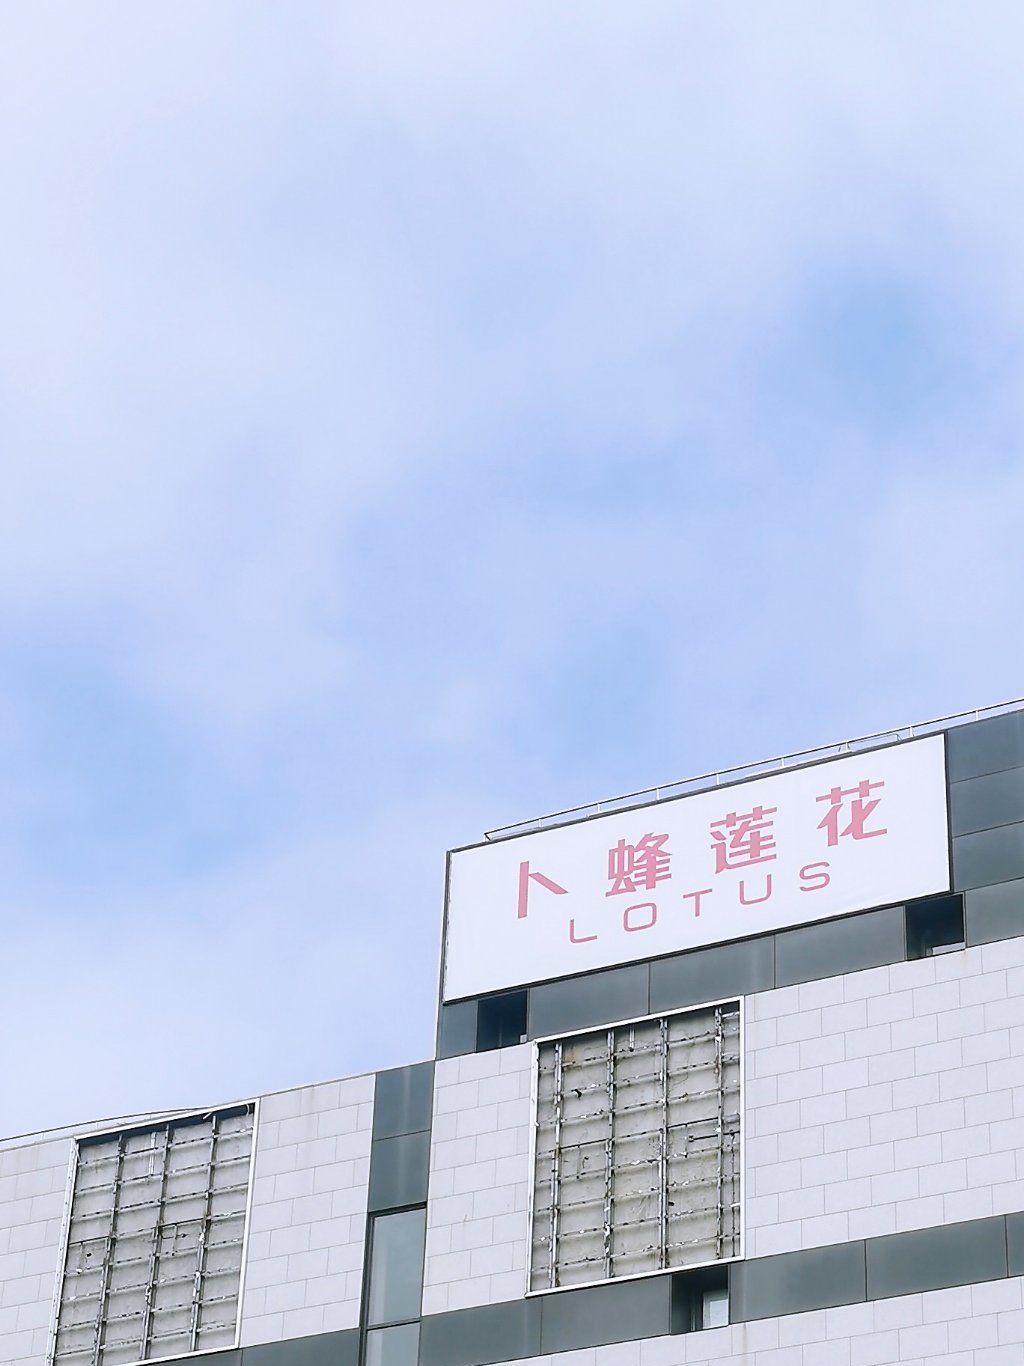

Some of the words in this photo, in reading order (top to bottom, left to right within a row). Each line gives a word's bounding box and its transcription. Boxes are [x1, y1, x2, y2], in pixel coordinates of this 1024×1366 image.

[516, 779, 888, 919] 卜蜂莲花
[569, 861, 831, 944] LOTUS
